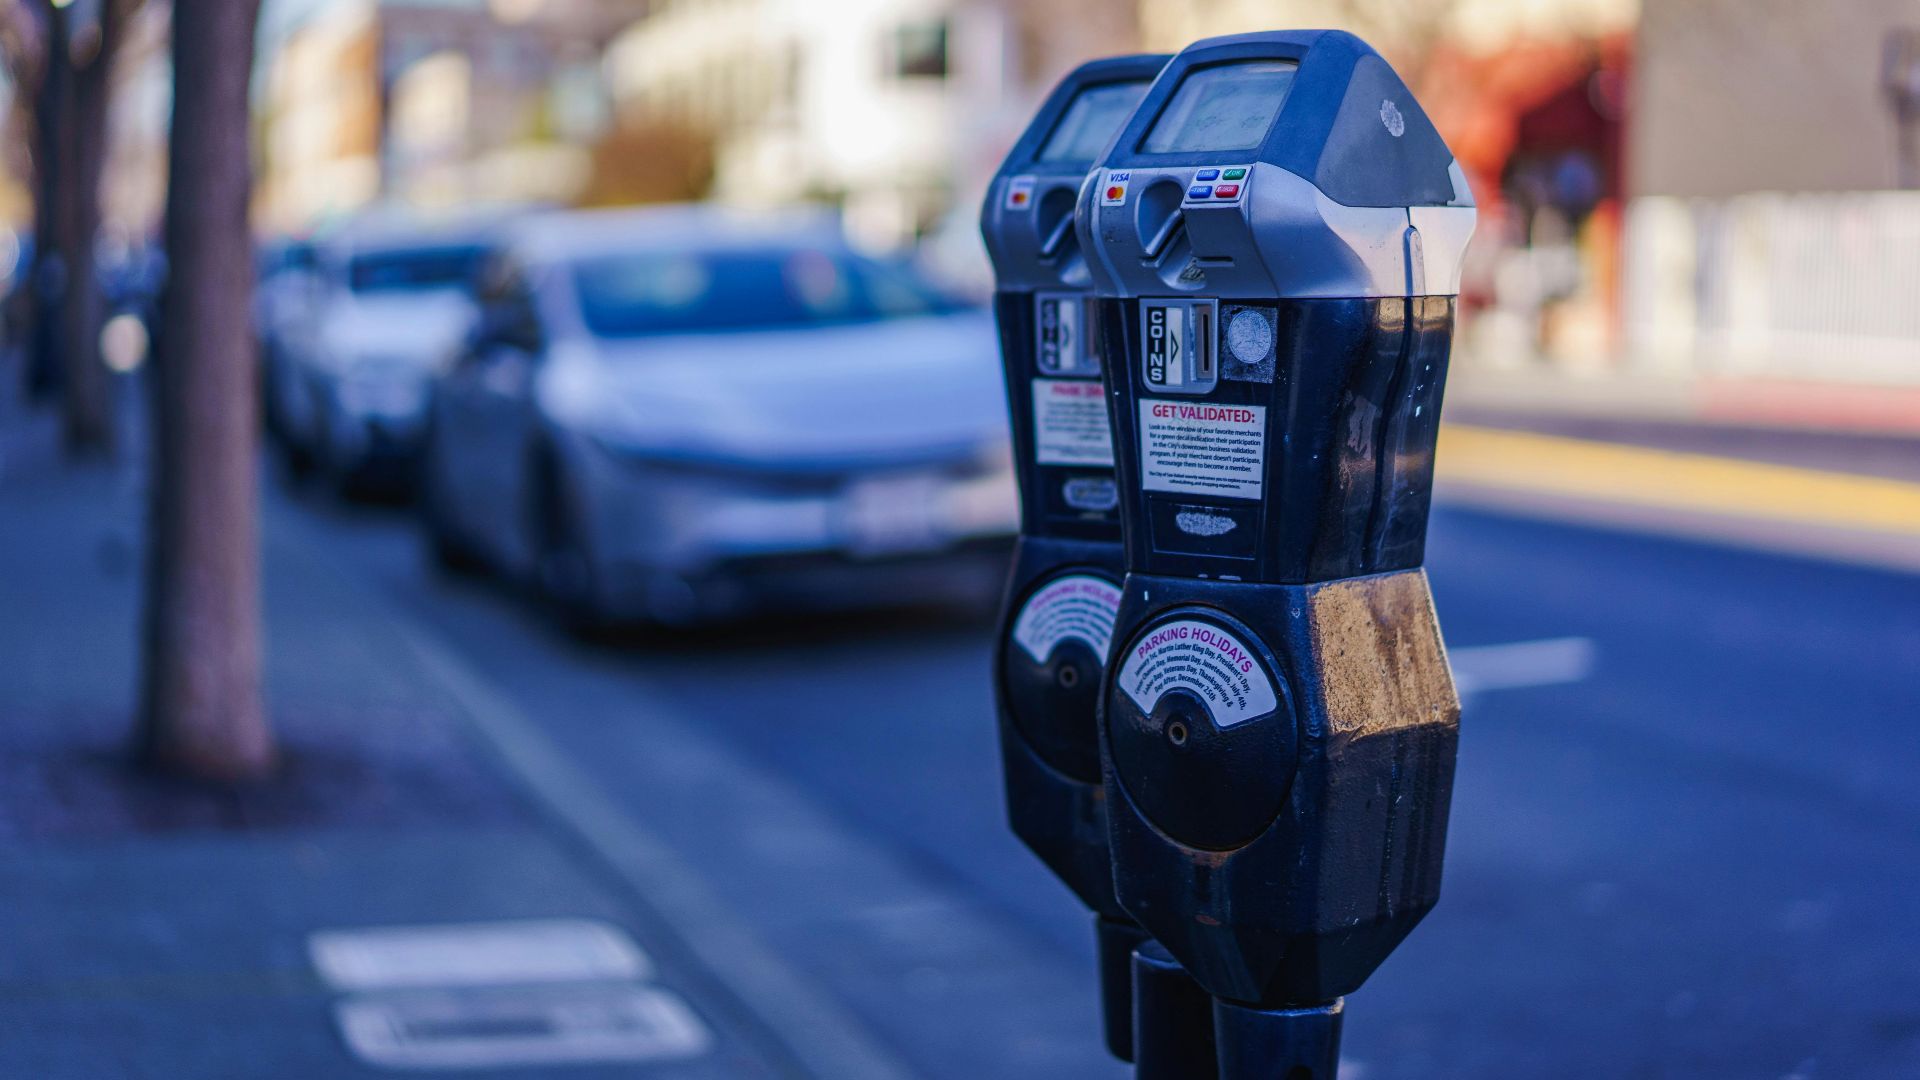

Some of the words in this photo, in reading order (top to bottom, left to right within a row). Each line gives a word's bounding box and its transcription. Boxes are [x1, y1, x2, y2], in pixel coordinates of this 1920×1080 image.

[1110, 172, 1130, 182] VISA
[1150, 311, 1162, 381] COINS
[1152, 404, 1176, 418] GET
[1178, 405, 1254, 423] VALIDATED:
[1215, 428, 1234, 436] favorite
[1235, 430, 1262, 438] merchants
[1228, 438, 1260, 446] participation
[1168, 442, 1180, 450] City's
[1208, 445, 1230, 453] business
[1232, 456, 1260, 464] participate,
[1138, 626, 1188, 658] PARKING
[1192, 628, 1252, 672] HOLIDAYS
[1158, 644, 1174, 654] Martin
[1174, 643, 1192, 652] Luther
[1192, 644, 1204, 655] King
[1205, 648, 1216, 659] Day,
[1216, 654, 1244, 681] President's
[1240, 678, 1251, 694] Day,
[1154, 682, 1164, 694] Day
[1178, 674, 1204, 689] December
[1203, 686, 1217, 702] 25th
[1164, 665, 1186, 674] Veterans
[1186, 664, 1198, 675] Day,
[1198, 668, 1230, 702] Thanksgiving
[1167, 654, 1190, 662] Memorial
[1191, 655, 1202, 666] Day,
[1202, 660, 1231, 686] Juneteenth,
[1230, 684, 1241, 697] July
[1239, 696, 1248, 710] 4th,
